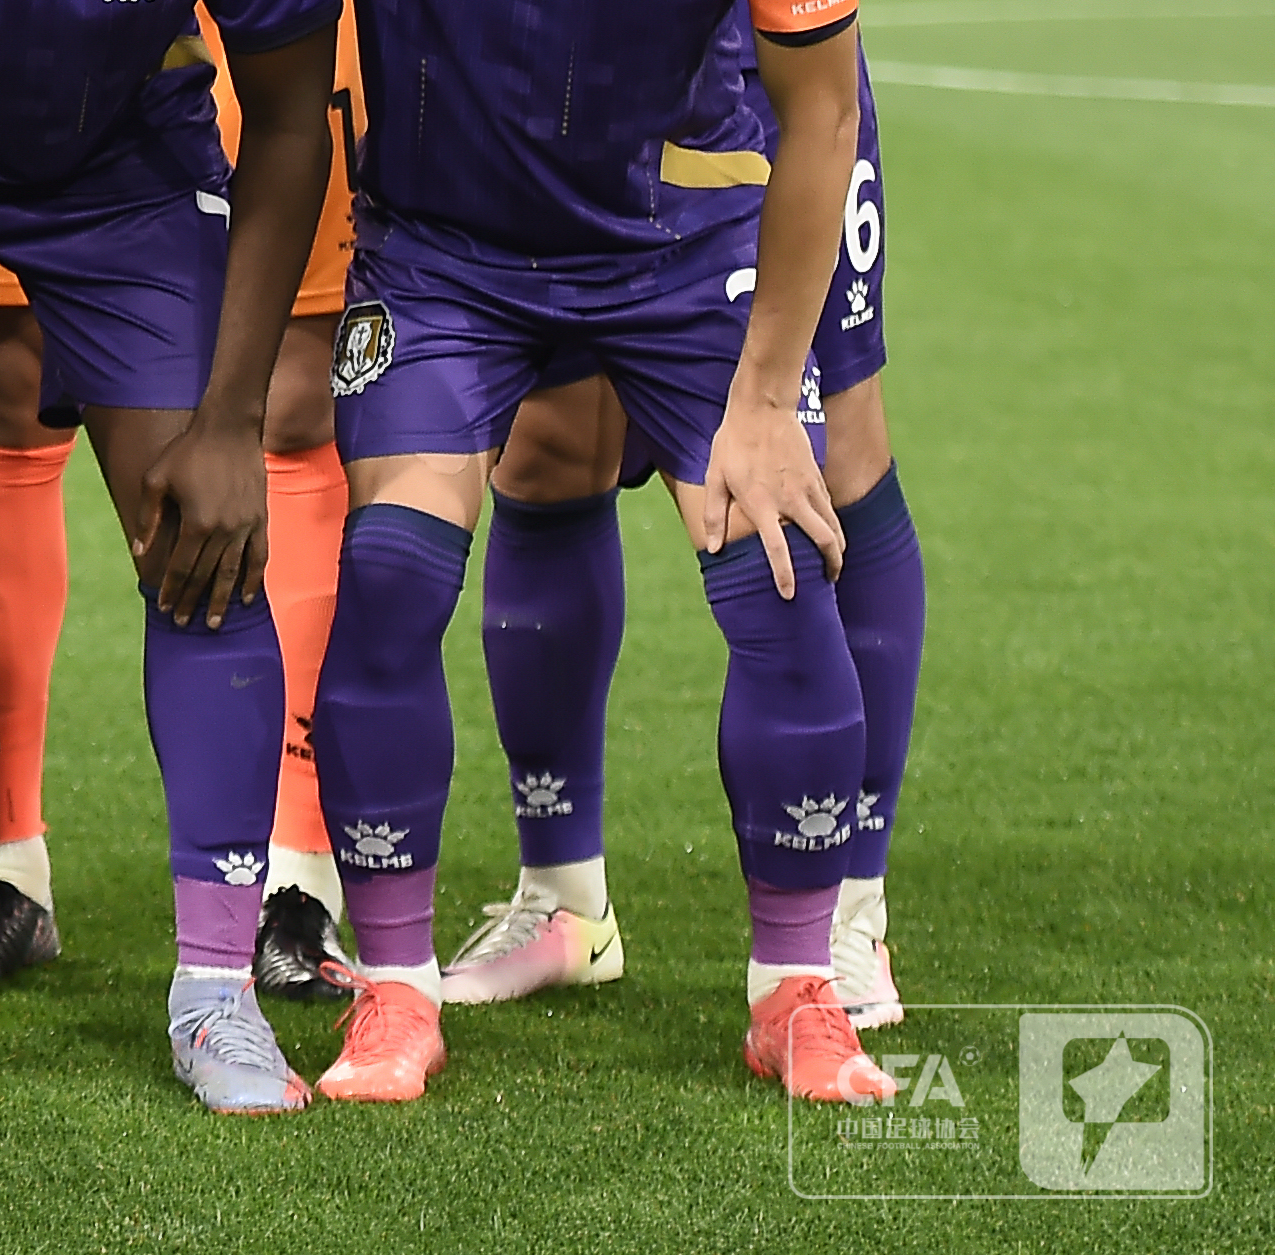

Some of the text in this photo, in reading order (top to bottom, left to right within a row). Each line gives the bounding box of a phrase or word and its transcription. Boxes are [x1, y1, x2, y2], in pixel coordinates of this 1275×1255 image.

[832, 158, 881, 273] 6
[841, 306, 875, 331] KELME
[515, 801, 573, 818] KELME
[775, 822, 851, 850] KELME
[340, 848, 414, 869] KELME
